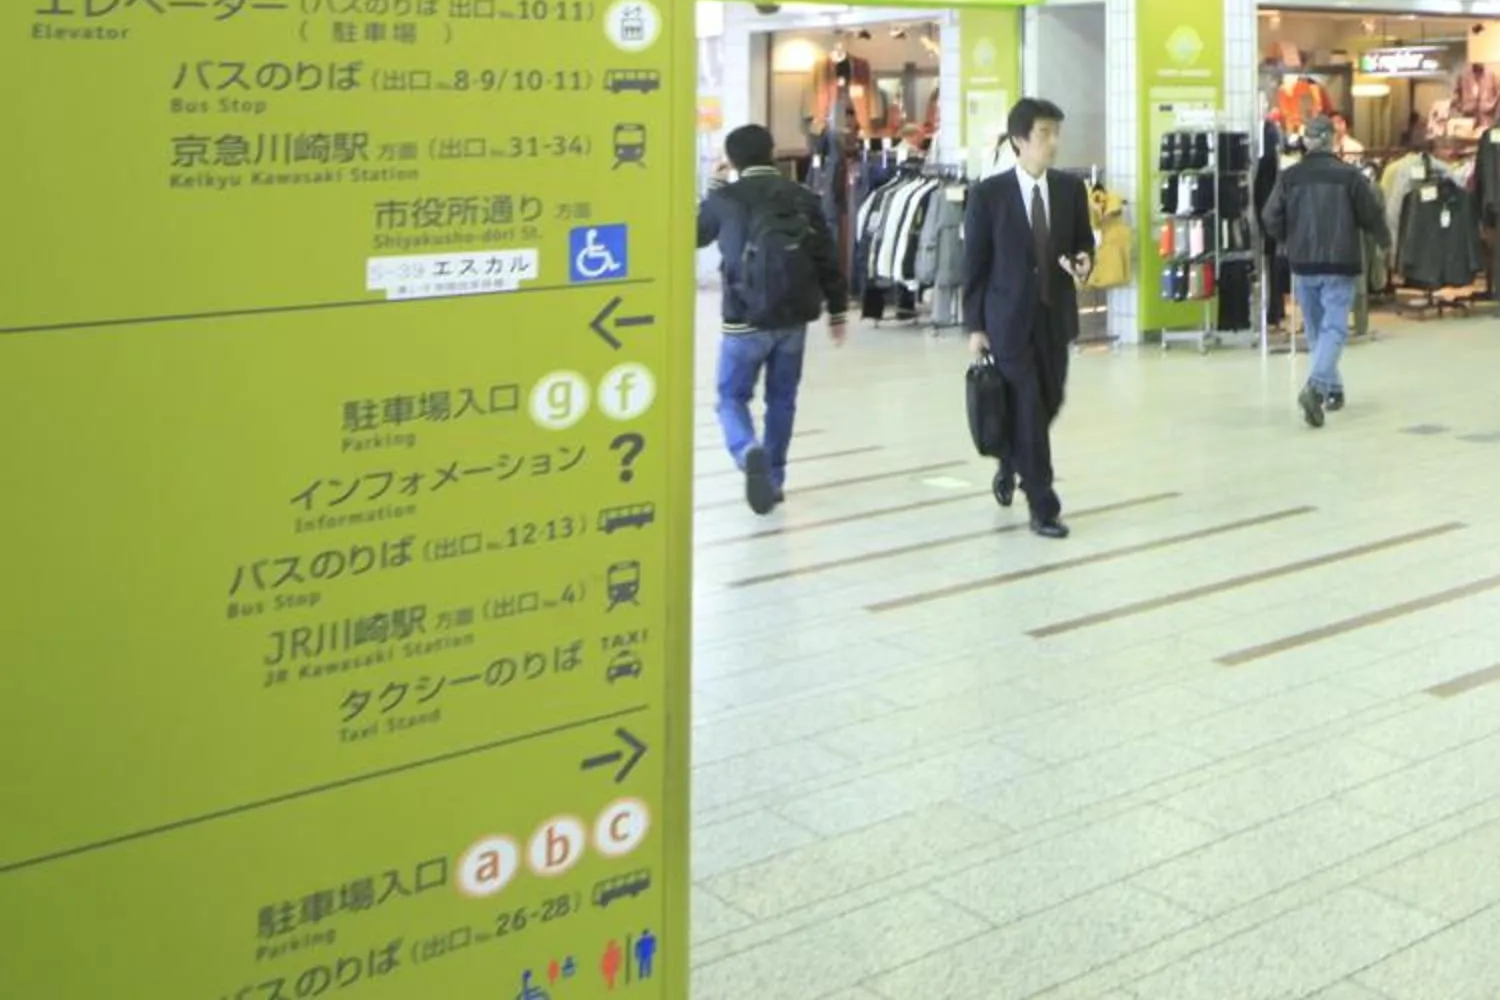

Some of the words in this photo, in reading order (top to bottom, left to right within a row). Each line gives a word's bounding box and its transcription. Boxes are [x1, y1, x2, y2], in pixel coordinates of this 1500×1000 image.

[31, 23, 130, 40] Elevator
[171, 61, 363, 91] バスのりば
[170, 98, 208, 113] Bus
[218, 97, 267, 115] Stop
[170, 132, 369, 168] 京急川崎駅
[169, 173, 242, 191] Keikyu
[250, 168, 342, 186] Kawasaki
[350, 166, 419, 184] Station
[374, 194, 543, 230] 市役所通り
[432, 255, 530, 276] エスカル
[341, 384, 519, 433] 駐車場入口
[341, 433, 416, 453] Parking
[290, 446, 586, 511] インフォメーション
[294, 504, 417, 534] Information
[229, 535, 416, 597] バスのりば
[227, 602, 264, 619] Bus
[274, 592, 321, 612] Stop
[264, 604, 427, 666] JR川崎駅
[299, 648, 394, 679] Kawasaki
[403, 633, 475, 659] Station
[339, 639, 586, 723] タクシーのりば
[339, 722, 378, 743] Taxi
[256, 856, 448, 938] 駐車場入口
